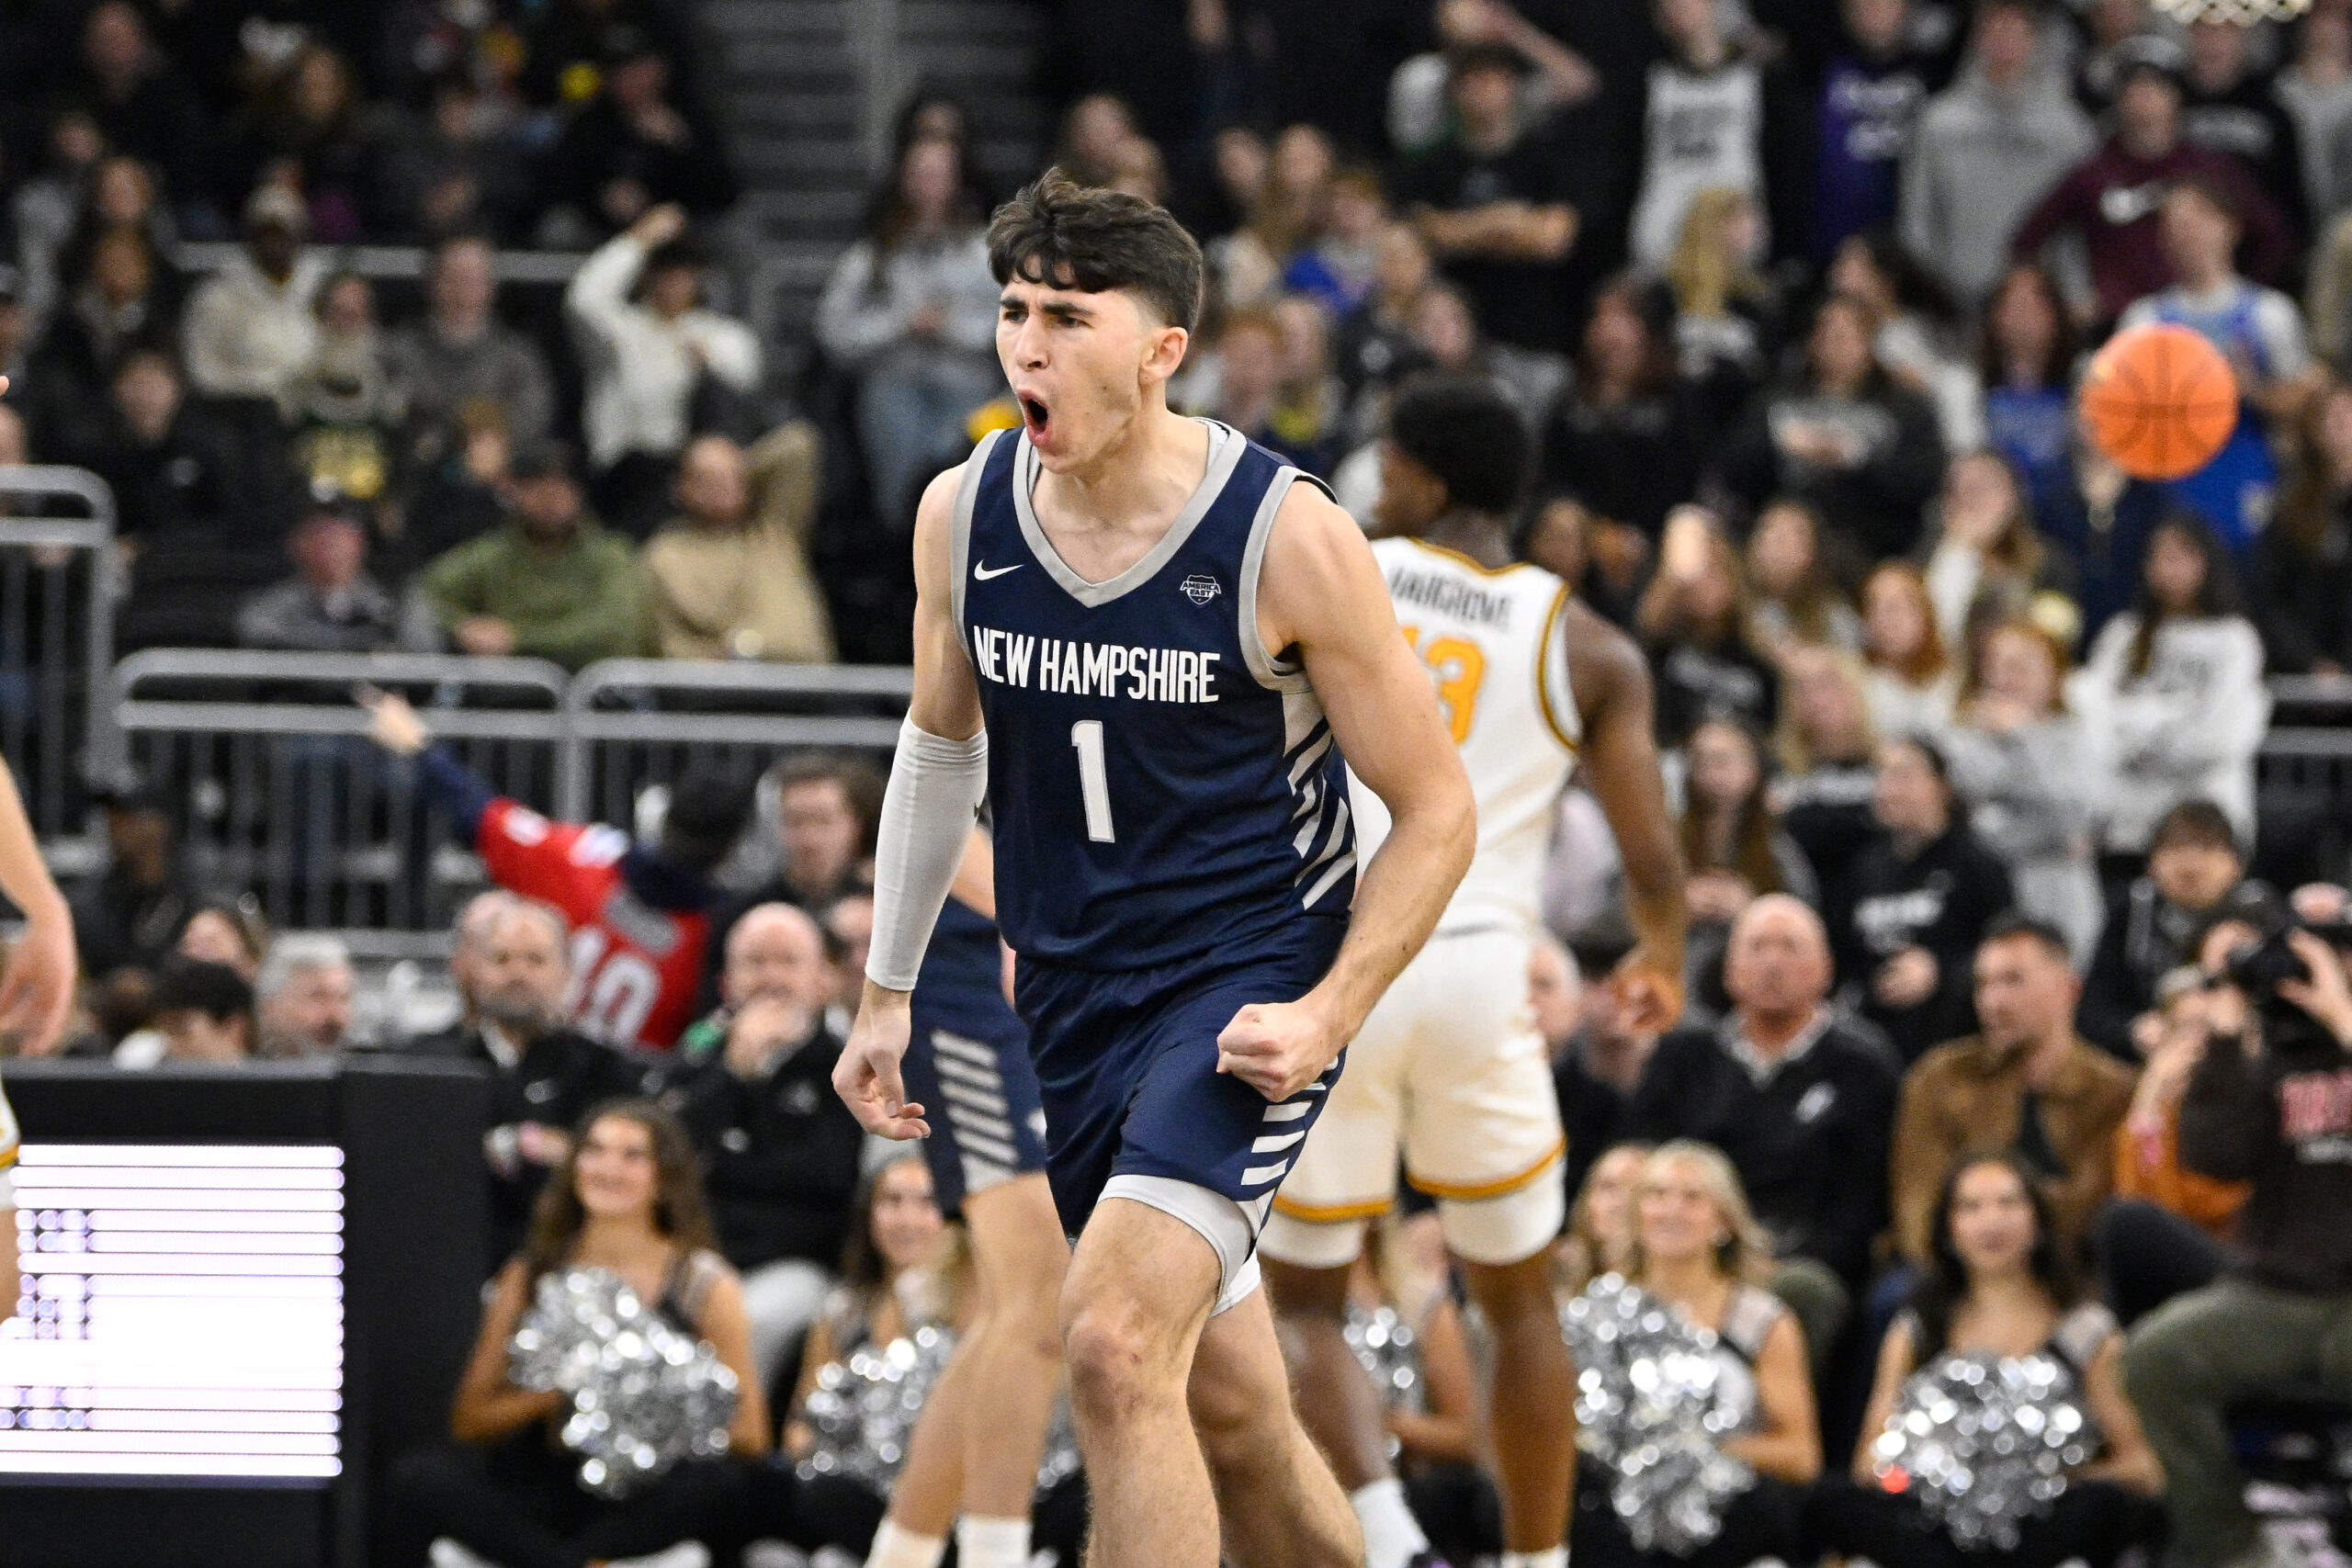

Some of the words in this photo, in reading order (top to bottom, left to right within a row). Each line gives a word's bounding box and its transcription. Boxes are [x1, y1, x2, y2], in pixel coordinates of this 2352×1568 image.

[1182, 581, 1220, 592] AMERICA
[1190, 589, 1211, 597] EAST
[973, 625, 1035, 688] NEW
[1039, 637, 1220, 704] HAMPSHIRE
[1071, 719, 1114, 842] 1
